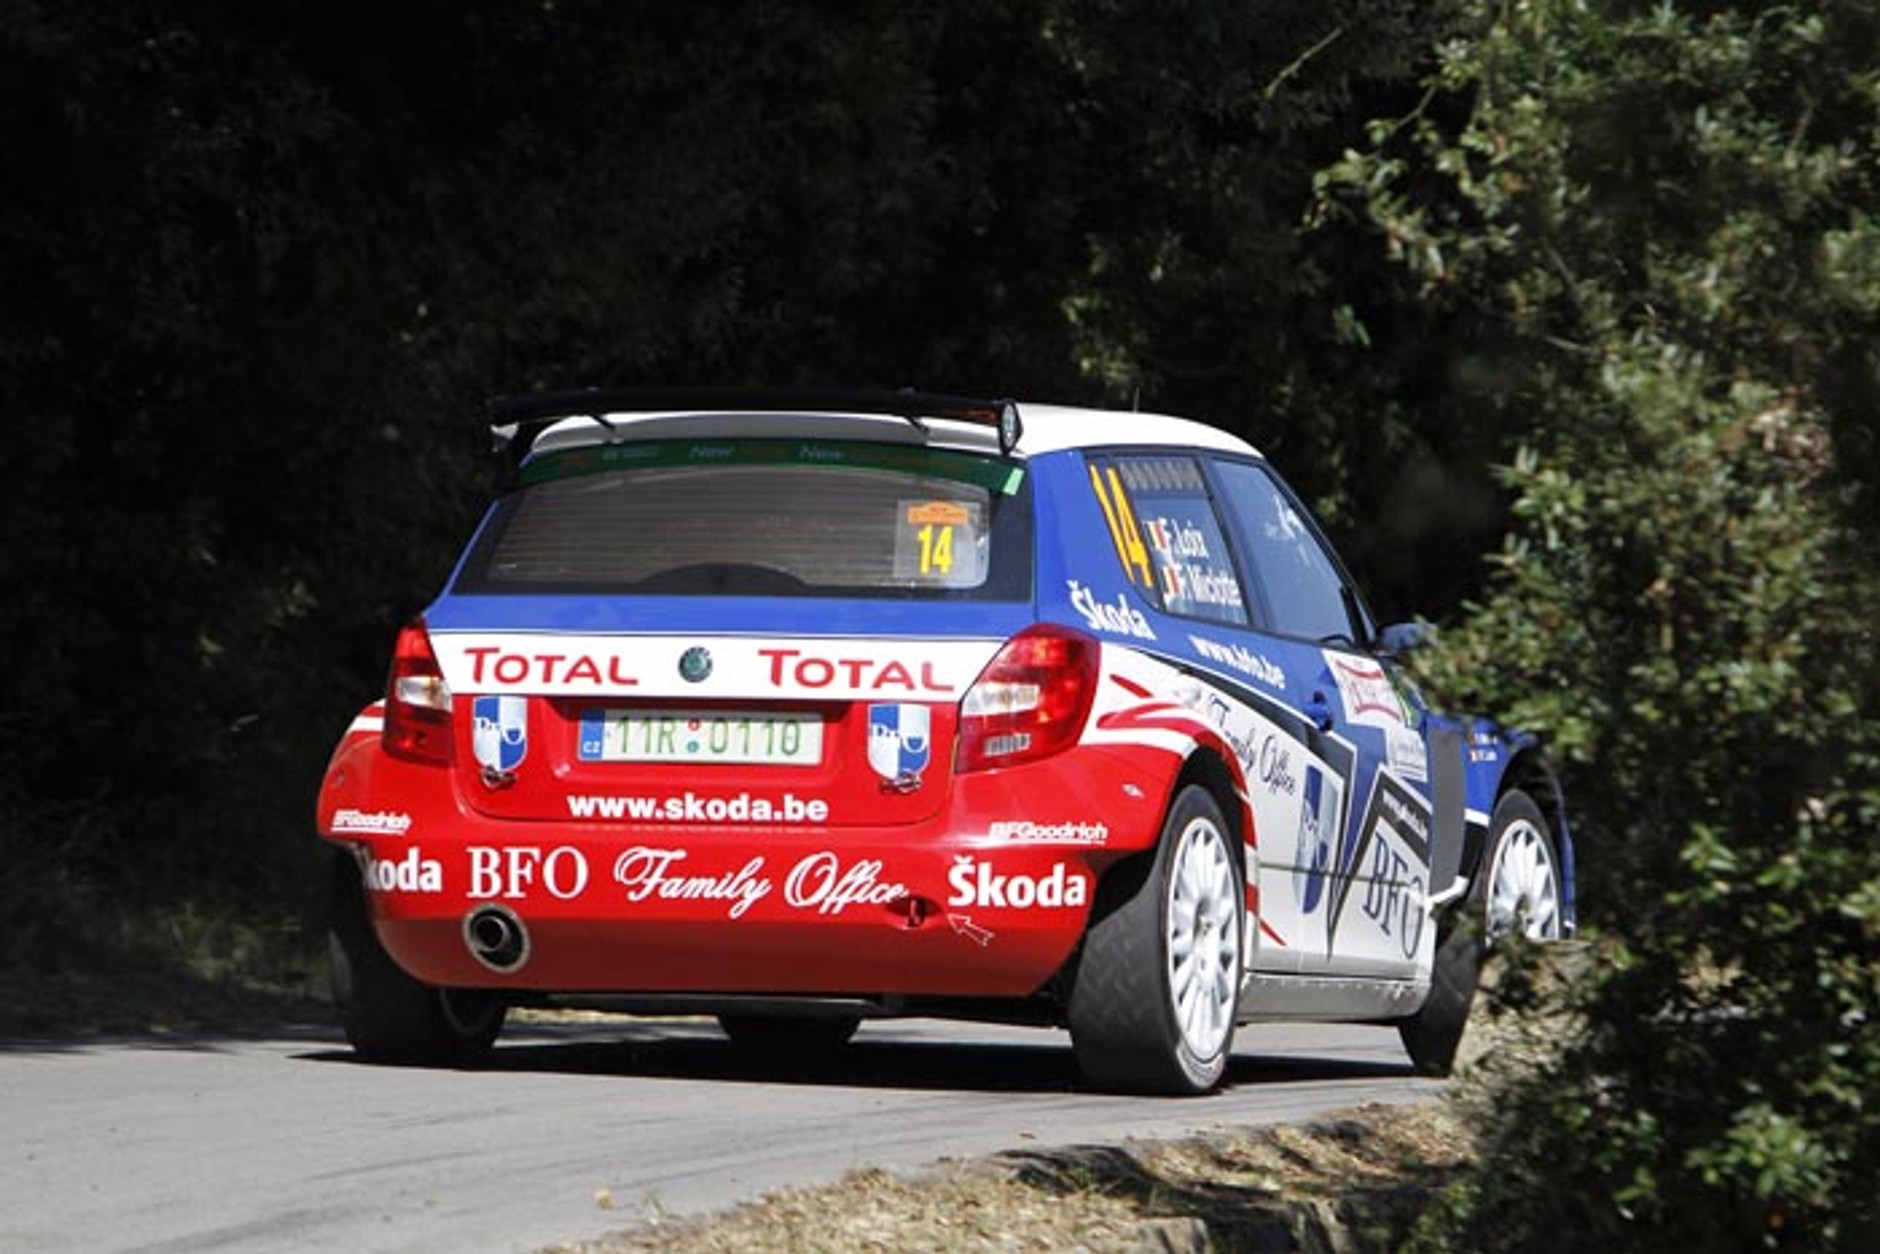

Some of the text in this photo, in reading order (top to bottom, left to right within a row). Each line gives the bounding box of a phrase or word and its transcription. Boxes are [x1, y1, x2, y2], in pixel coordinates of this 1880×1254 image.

[918, 523, 953, 576] 14
[1089, 463, 1154, 588] 14
[1066, 579, 1157, 641] Škoda
[464, 647, 639, 686] TOTAL
[758, 649, 955, 692] TOTAL
[616, 716, 801, 756] 11R 0110
[567, 792, 829, 822] www.skoda.be
[989, 821, 1108, 842] BFGoodrich
[466, 846, 909, 918] BFO Family Office
[948, 854, 1087, 908] Škoda
[1362, 832, 1425, 959] BFO
